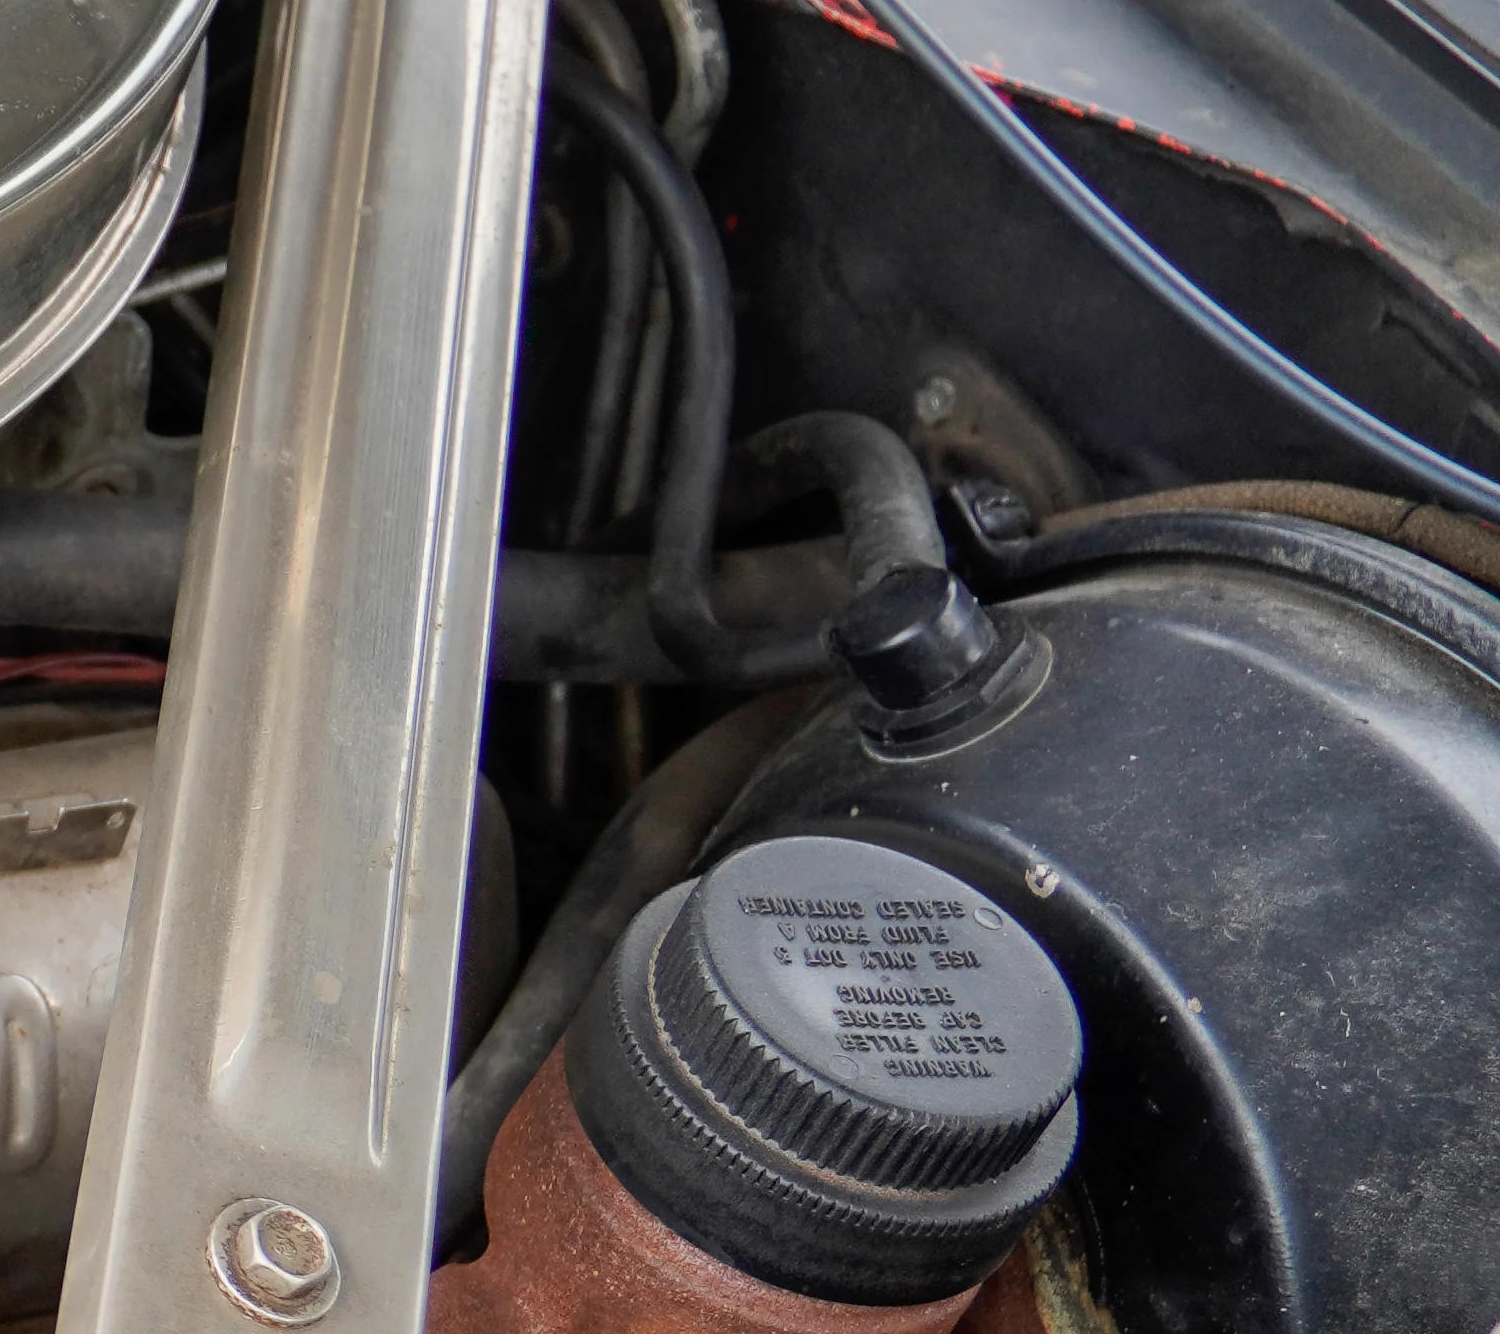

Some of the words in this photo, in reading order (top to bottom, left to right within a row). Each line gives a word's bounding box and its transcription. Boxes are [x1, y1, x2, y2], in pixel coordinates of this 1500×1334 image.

[738, 895, 866, 918] CONTAINER
[876, 898, 966, 919] SEALED
[777, 921, 796, 941] A
[805, 922, 871, 945] FROM
[881, 924, 950, 945] FLUID
[804, 947, 848, 968] DOT
[860, 949, 918, 970] ONLY
[929, 949, 982, 969] USE
[836, 984, 956, 1006] REMOVING
[833, 1008, 927, 1029] BEFORE
[938, 1010, 983, 1030] CAP
[835, 1033, 920, 1054] FILLER
[929, 1033, 1007, 1055] CLEAN
[883, 1058, 992, 1079] WARNING
